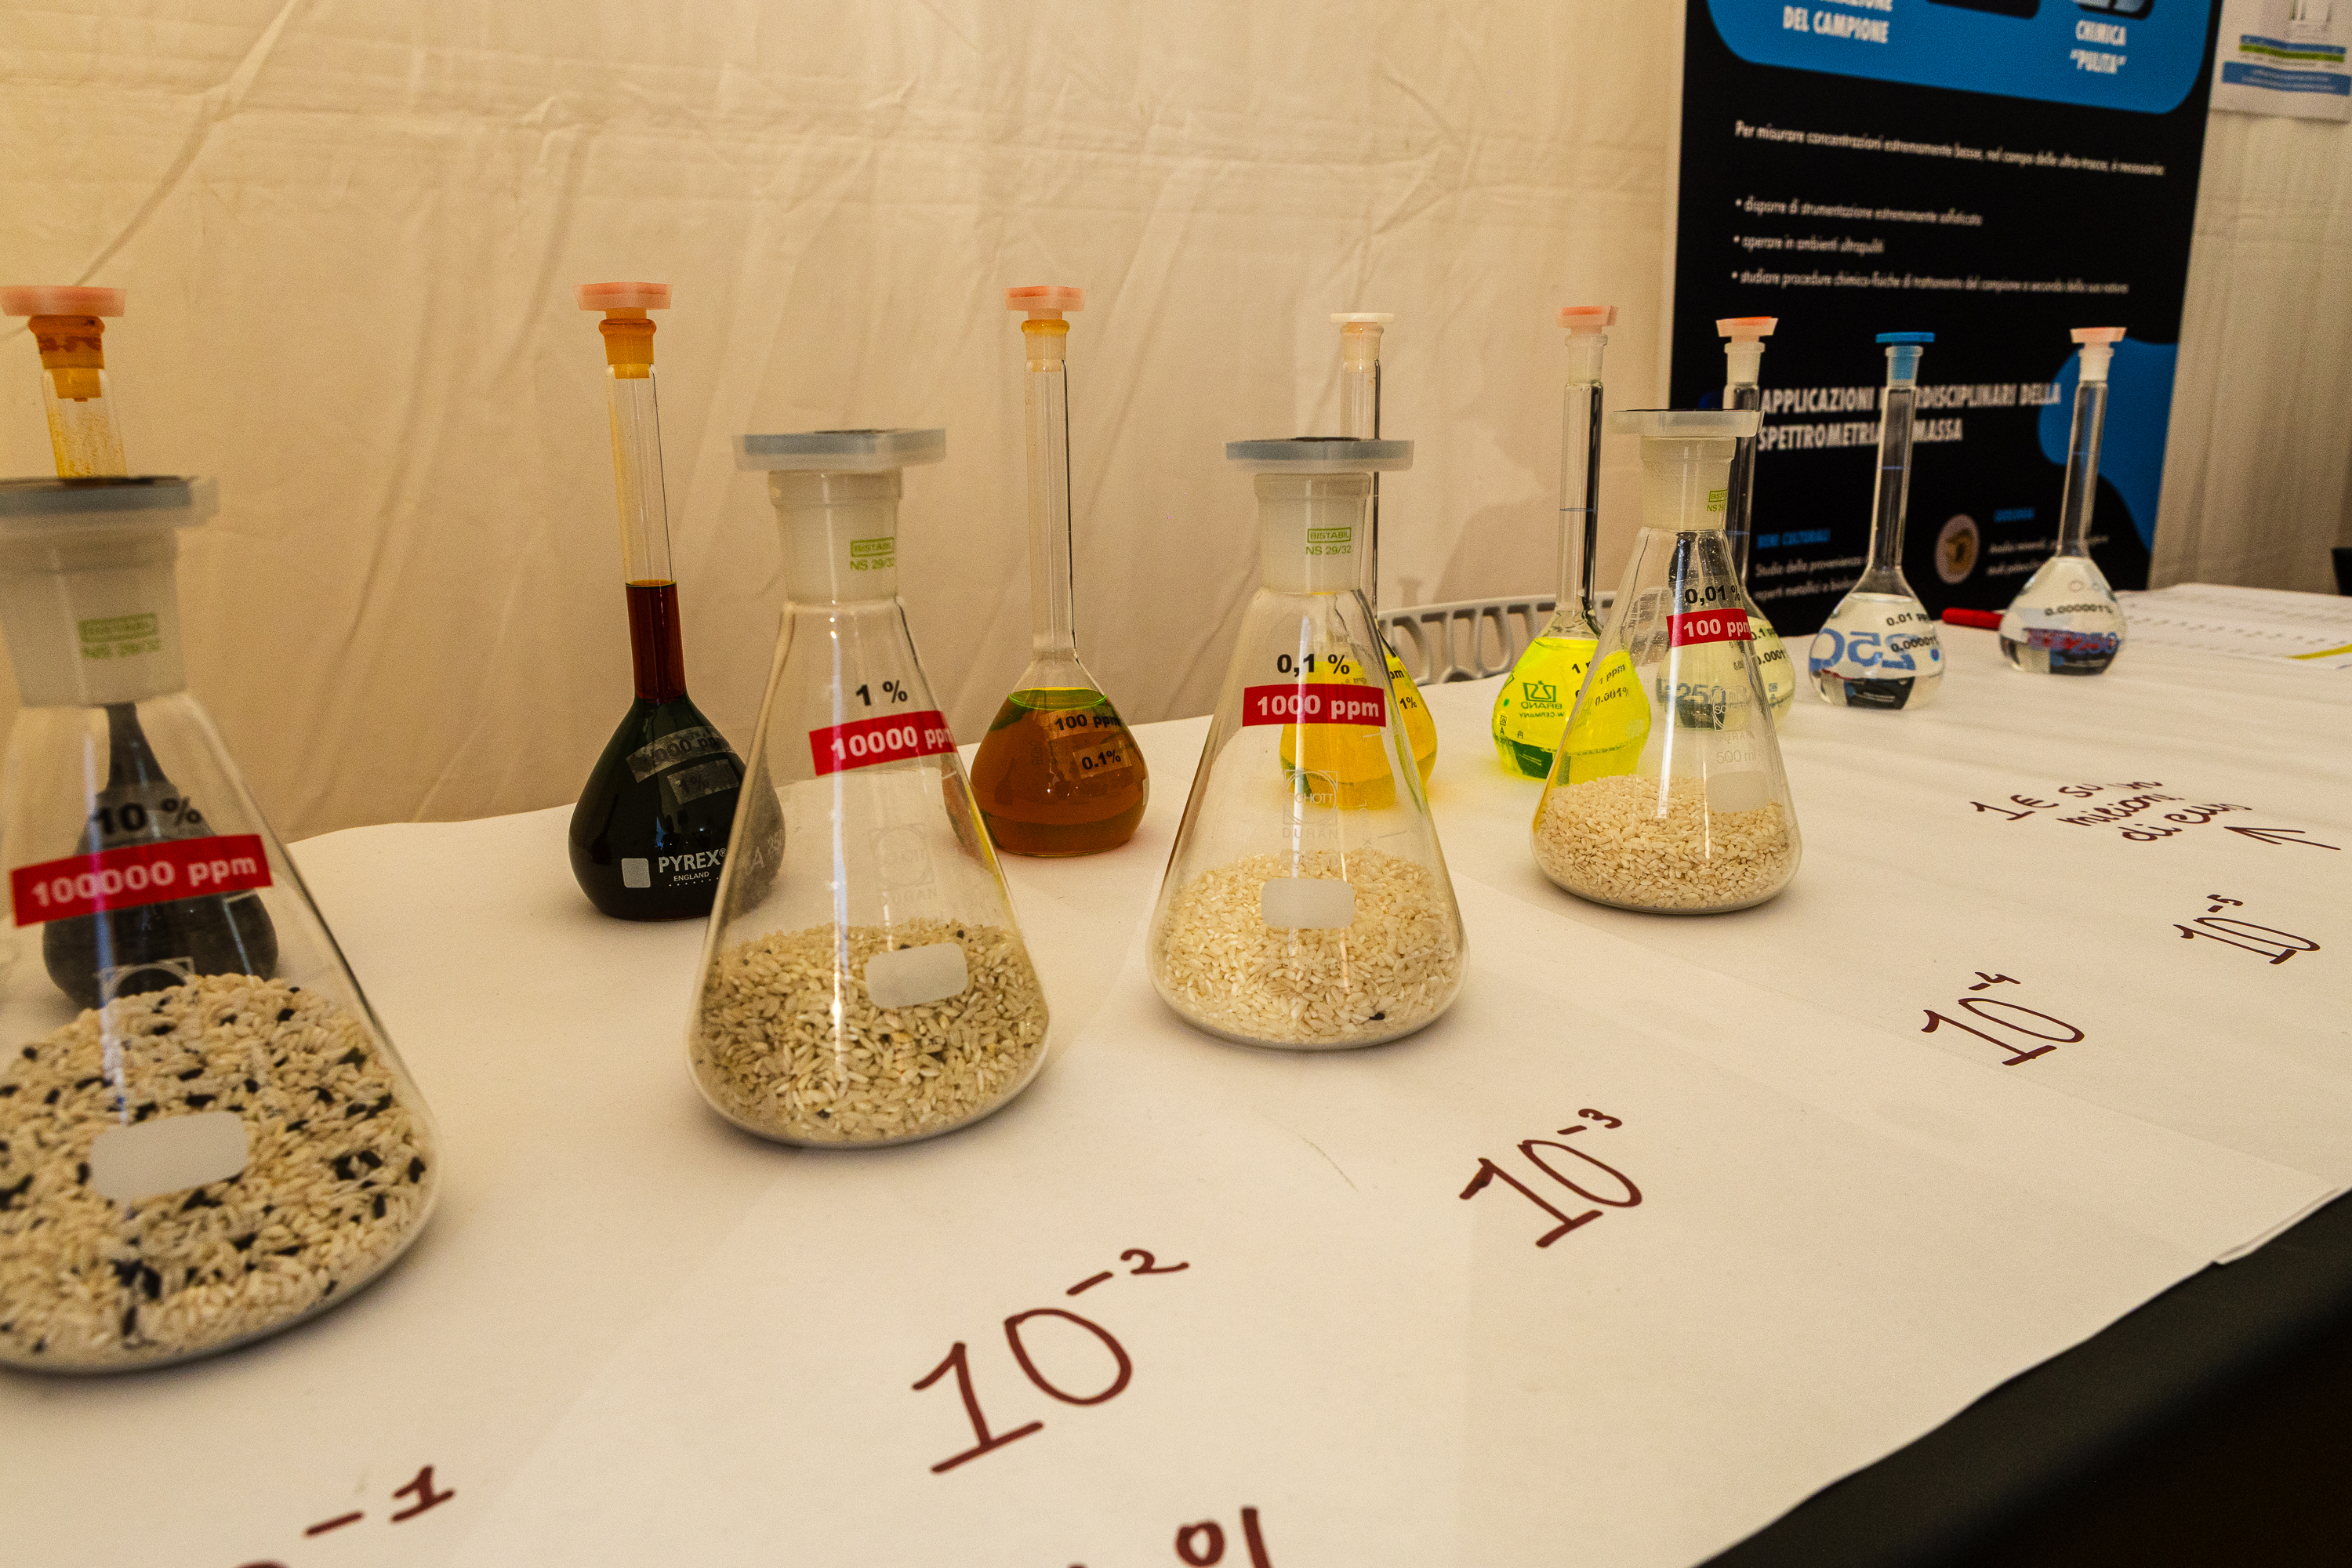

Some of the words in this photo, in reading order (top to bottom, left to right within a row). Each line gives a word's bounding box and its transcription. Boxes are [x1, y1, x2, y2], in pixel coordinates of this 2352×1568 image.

[1783, 5, 1809, 32] DEL
[1813, 10, 1889, 44] CAMPIONE
[1735, 119, 1755, 138] Per
[1756, 123, 1805, 143] misurare
[1761, 387, 1875, 415] APPLICAZIONI
[2020, 382, 2062, 406] DELLA
[1757, 421, 1882, 452] SPETTROMETRIA
[1913, 417, 1963, 444] MASSA
[1310, 531, 1348, 540] BISTABIL
[1306, 546, 1323, 556] NS
[1326, 544, 1352, 555] 29/32
[1685, 585, 1726, 606] 0,01
[1730, 585, 1741, 601] %
[1683, 618, 1722, 637] 100
[1886, 612, 1913, 626] 0.01
[1276, 653, 1315, 677] 0,1
[1327, 654, 1350, 676] %
[855, 684, 871, 706] 1
[882, 680, 909, 704] %
[1257, 694, 1321, 717] 1000
[1330, 699, 1380, 720] ppm
[1054, 713, 1088, 731] 100
[1092, 715, 1122, 729] ppm
[830, 725, 918, 760] 10000
[1081, 749, 1122, 771] 0.1%
[1715, 750, 1742, 764] 500
[95, 803, 147, 835] 10
[160, 797, 202, 828] %
[2117, 822, 2183, 842] di
[31, 861, 176, 908] 100000
[187, 857, 258, 887] ppm
[673, 871, 710, 882] ENGLAND
